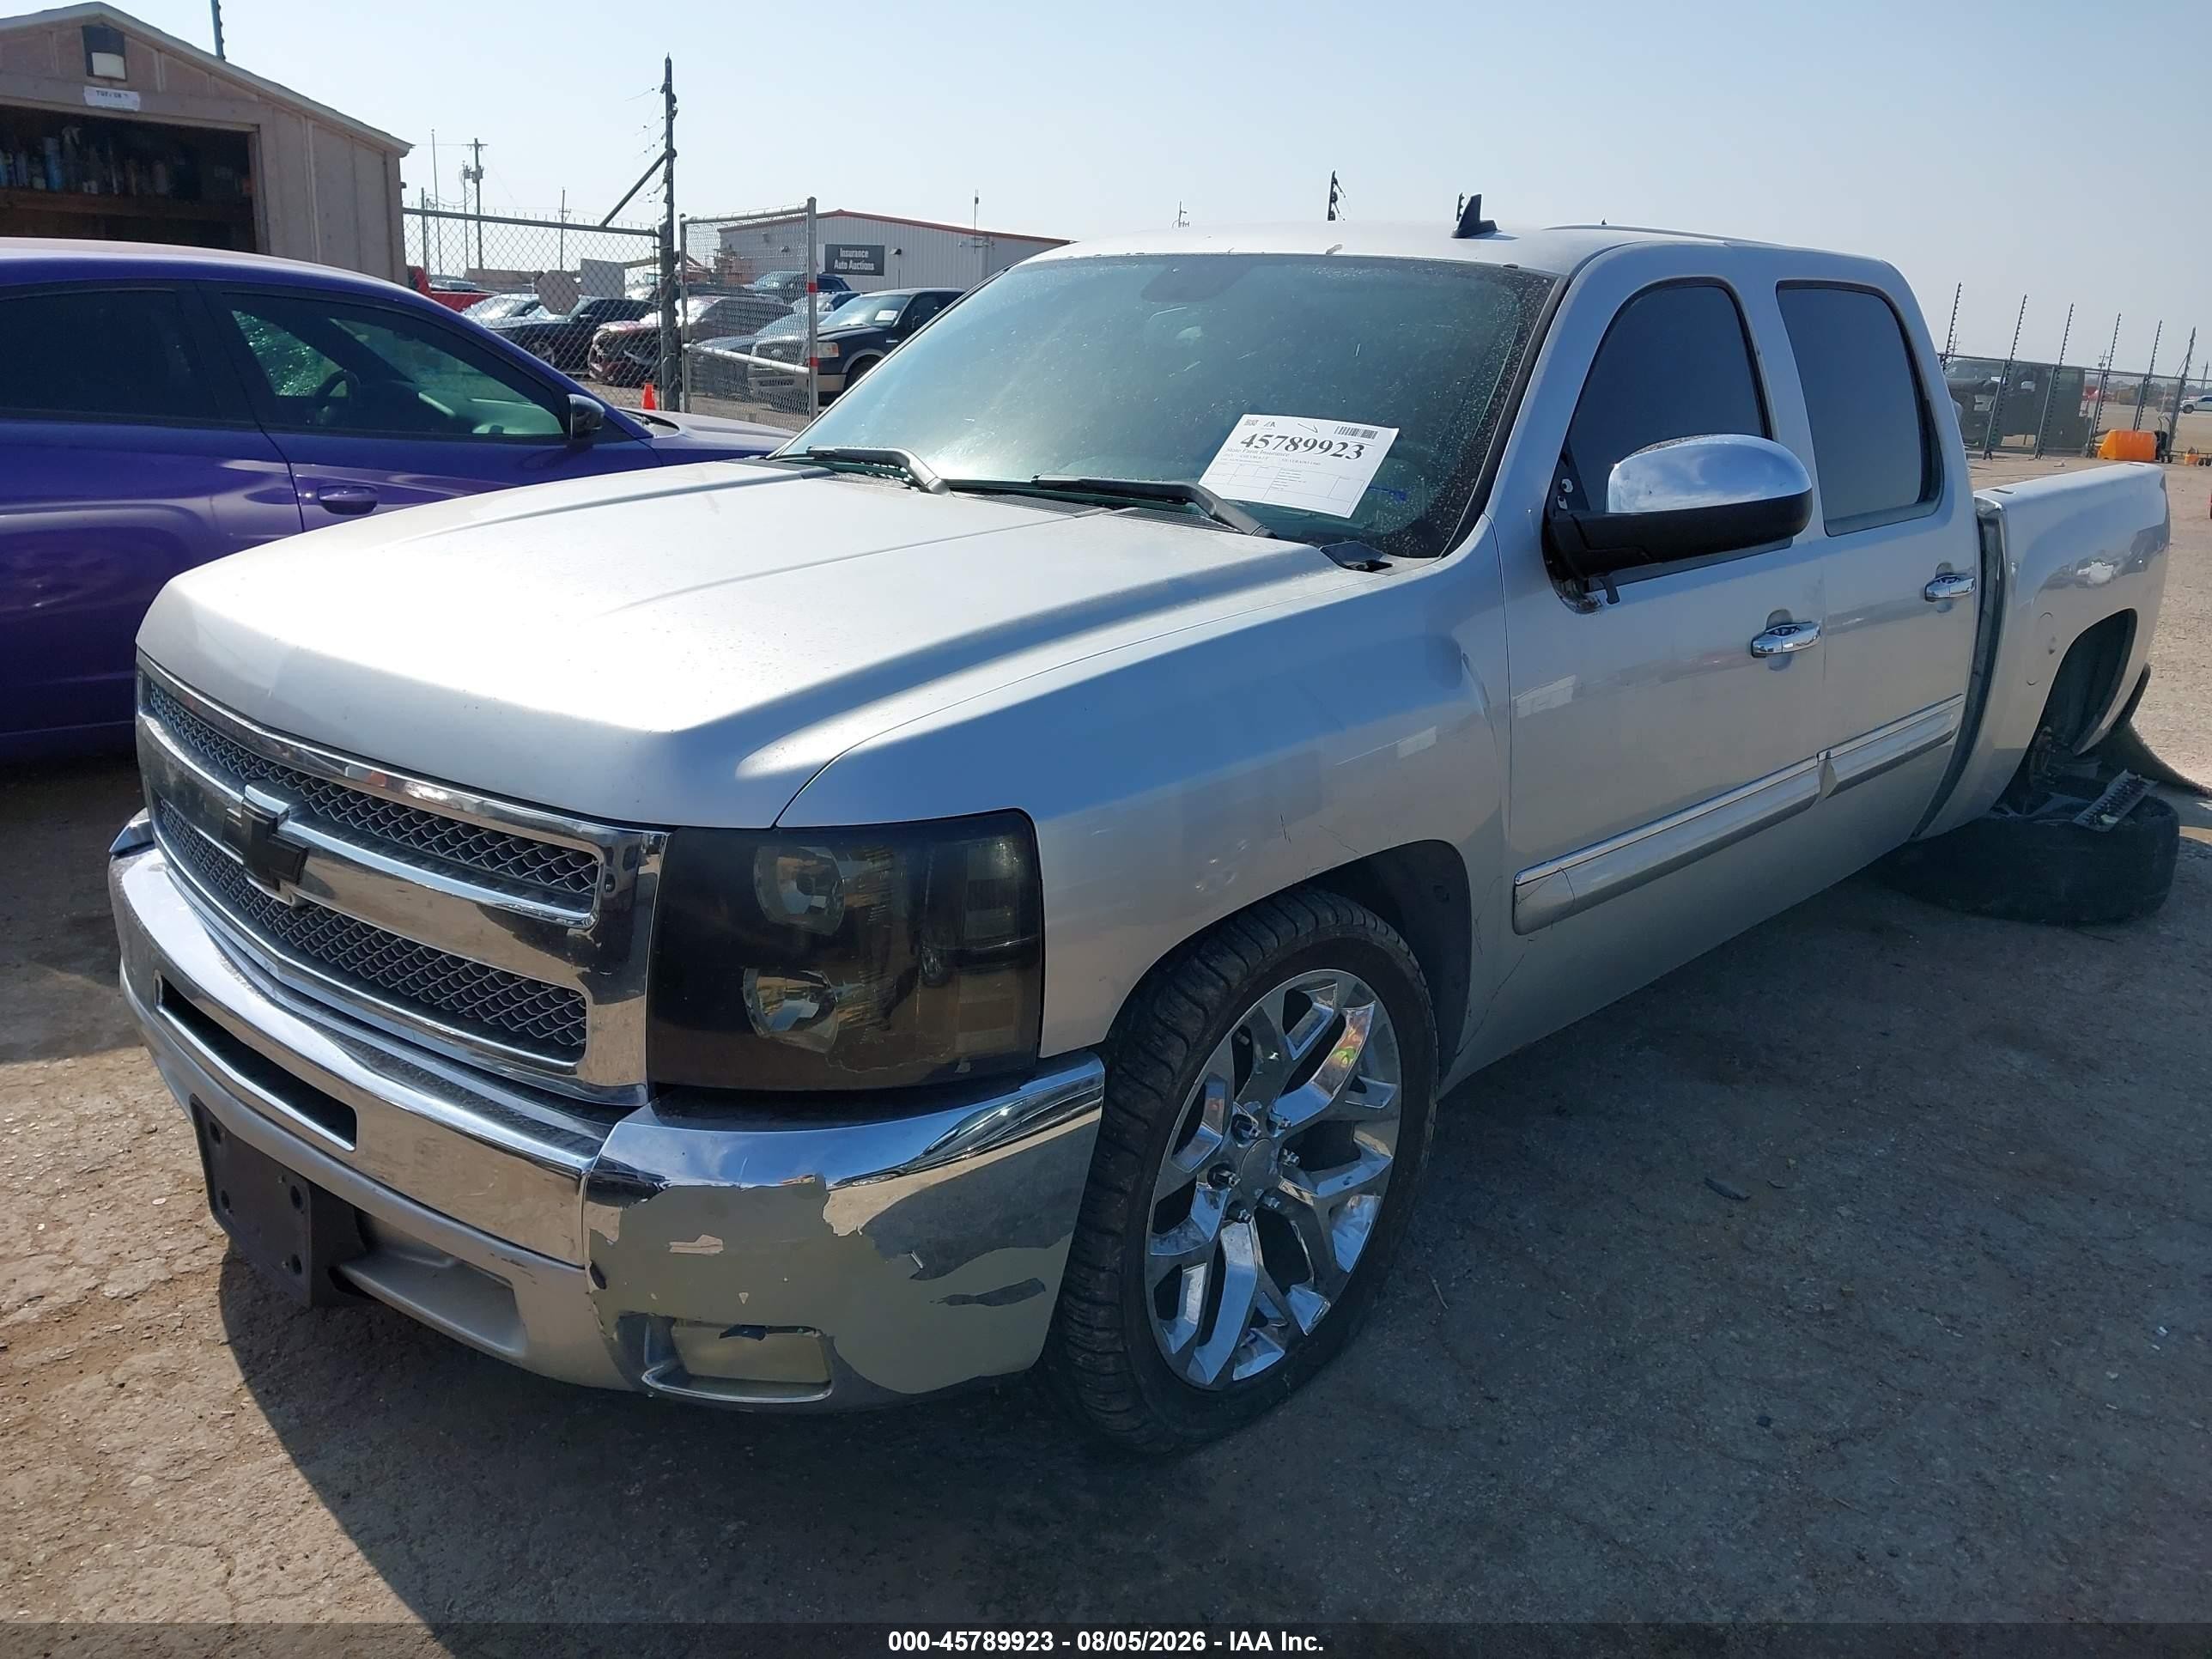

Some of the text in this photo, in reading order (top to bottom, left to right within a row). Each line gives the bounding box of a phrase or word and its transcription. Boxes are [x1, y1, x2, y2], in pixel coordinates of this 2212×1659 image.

[839, 248, 869, 258] Insurance
[834, 259, 875, 270] Auto Auctions
[1240, 433, 1367, 460] 45789923
